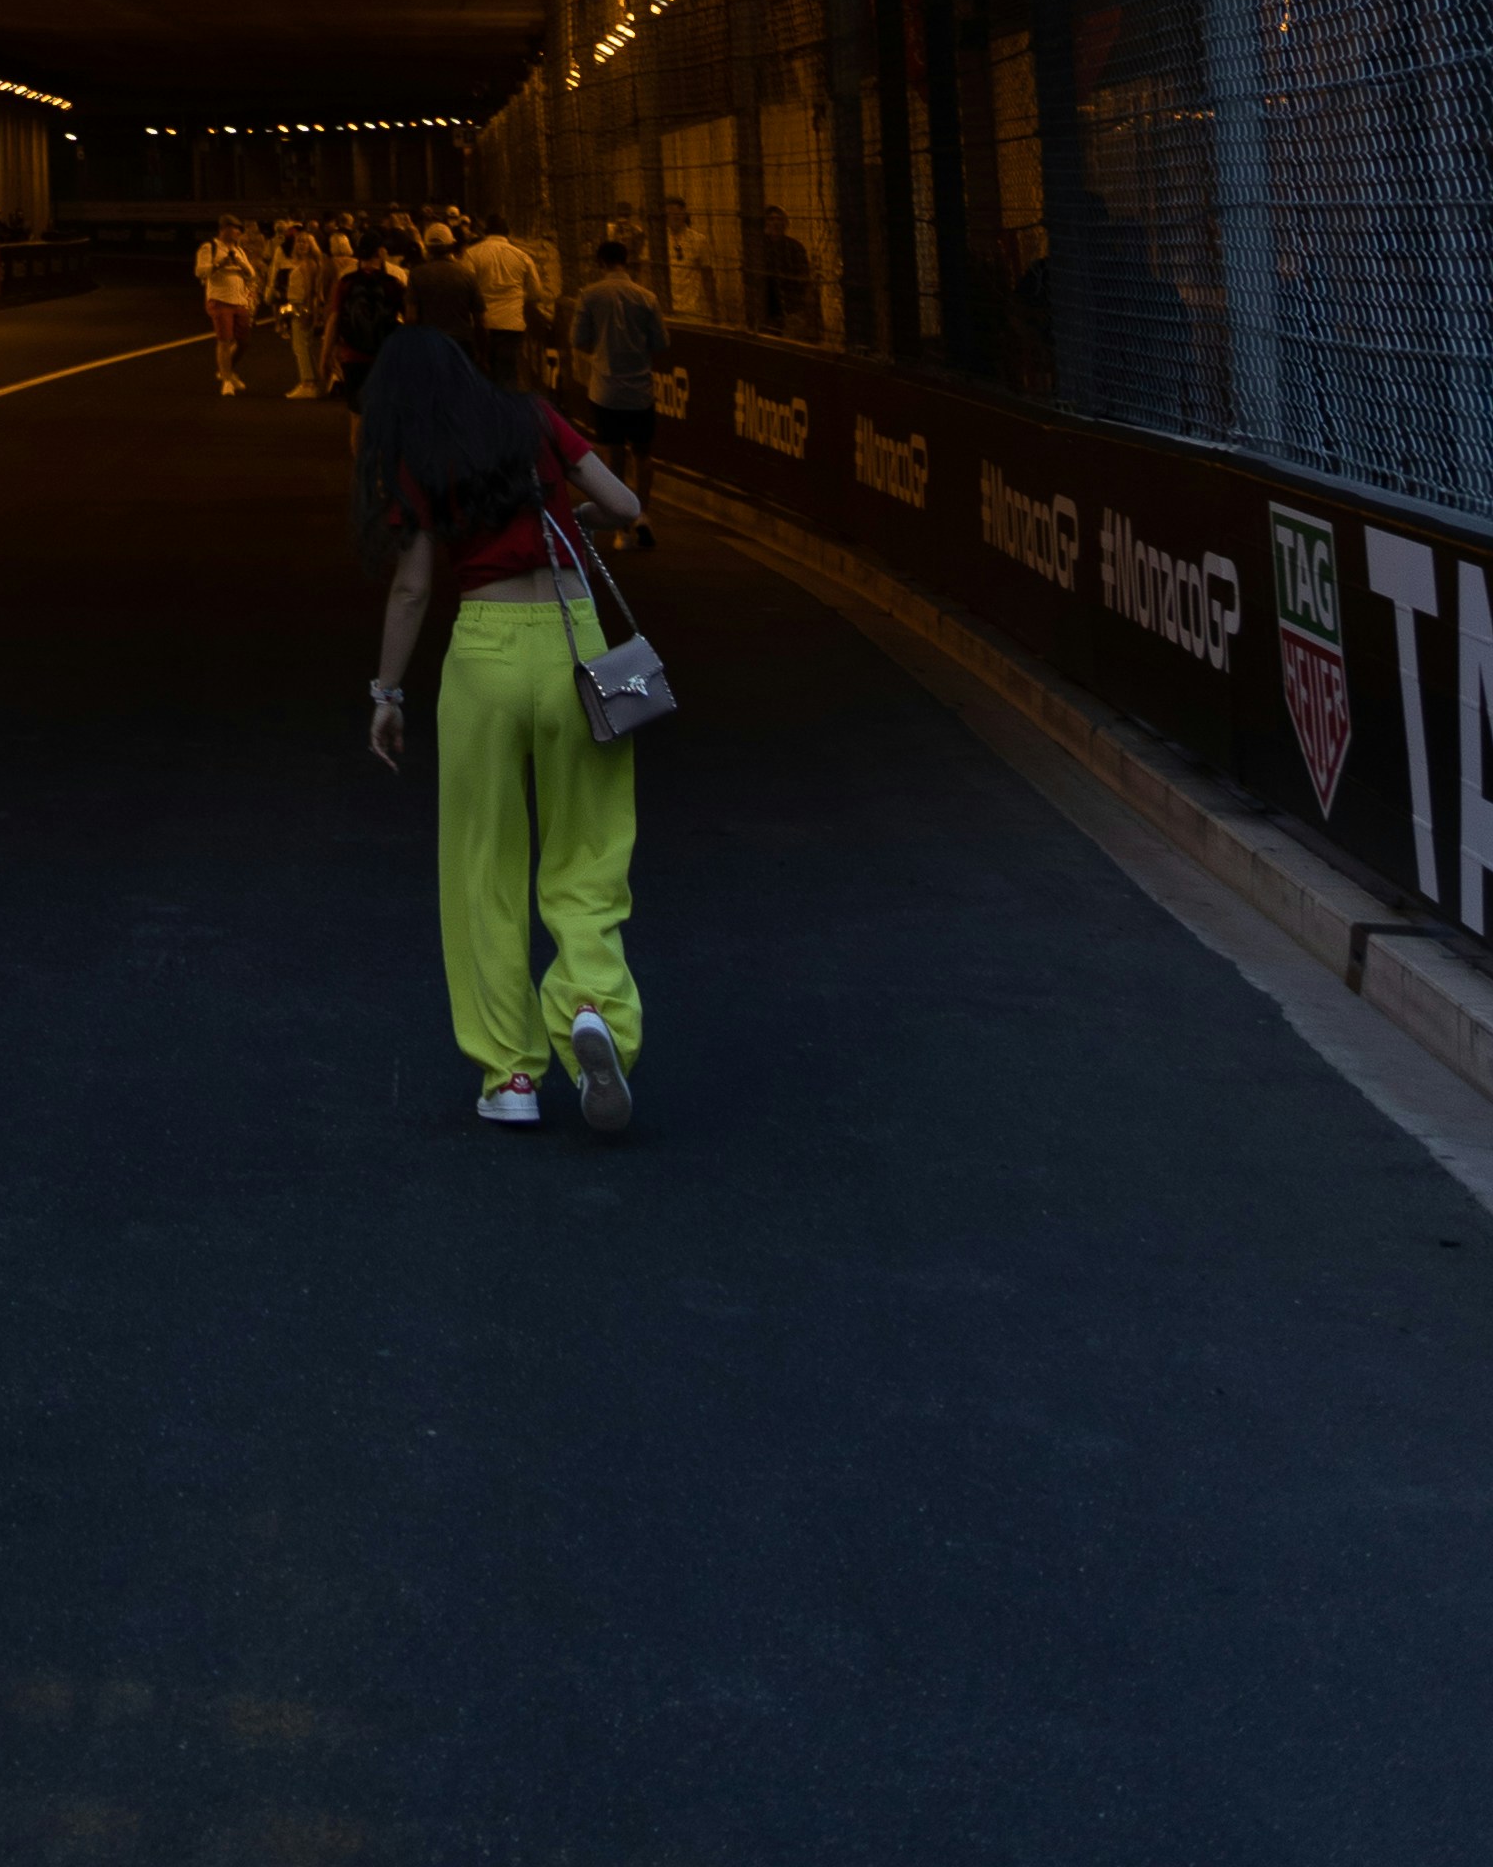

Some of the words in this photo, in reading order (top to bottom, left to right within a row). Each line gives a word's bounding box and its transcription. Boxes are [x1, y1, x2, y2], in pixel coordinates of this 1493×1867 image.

[980, 459, 1079, 592] #MonacoGP
[1100, 506, 1241, 674] #MonacoGP
[1275, 523, 1336, 633] TAG
[1283, 639, 1347, 793] HEUER
